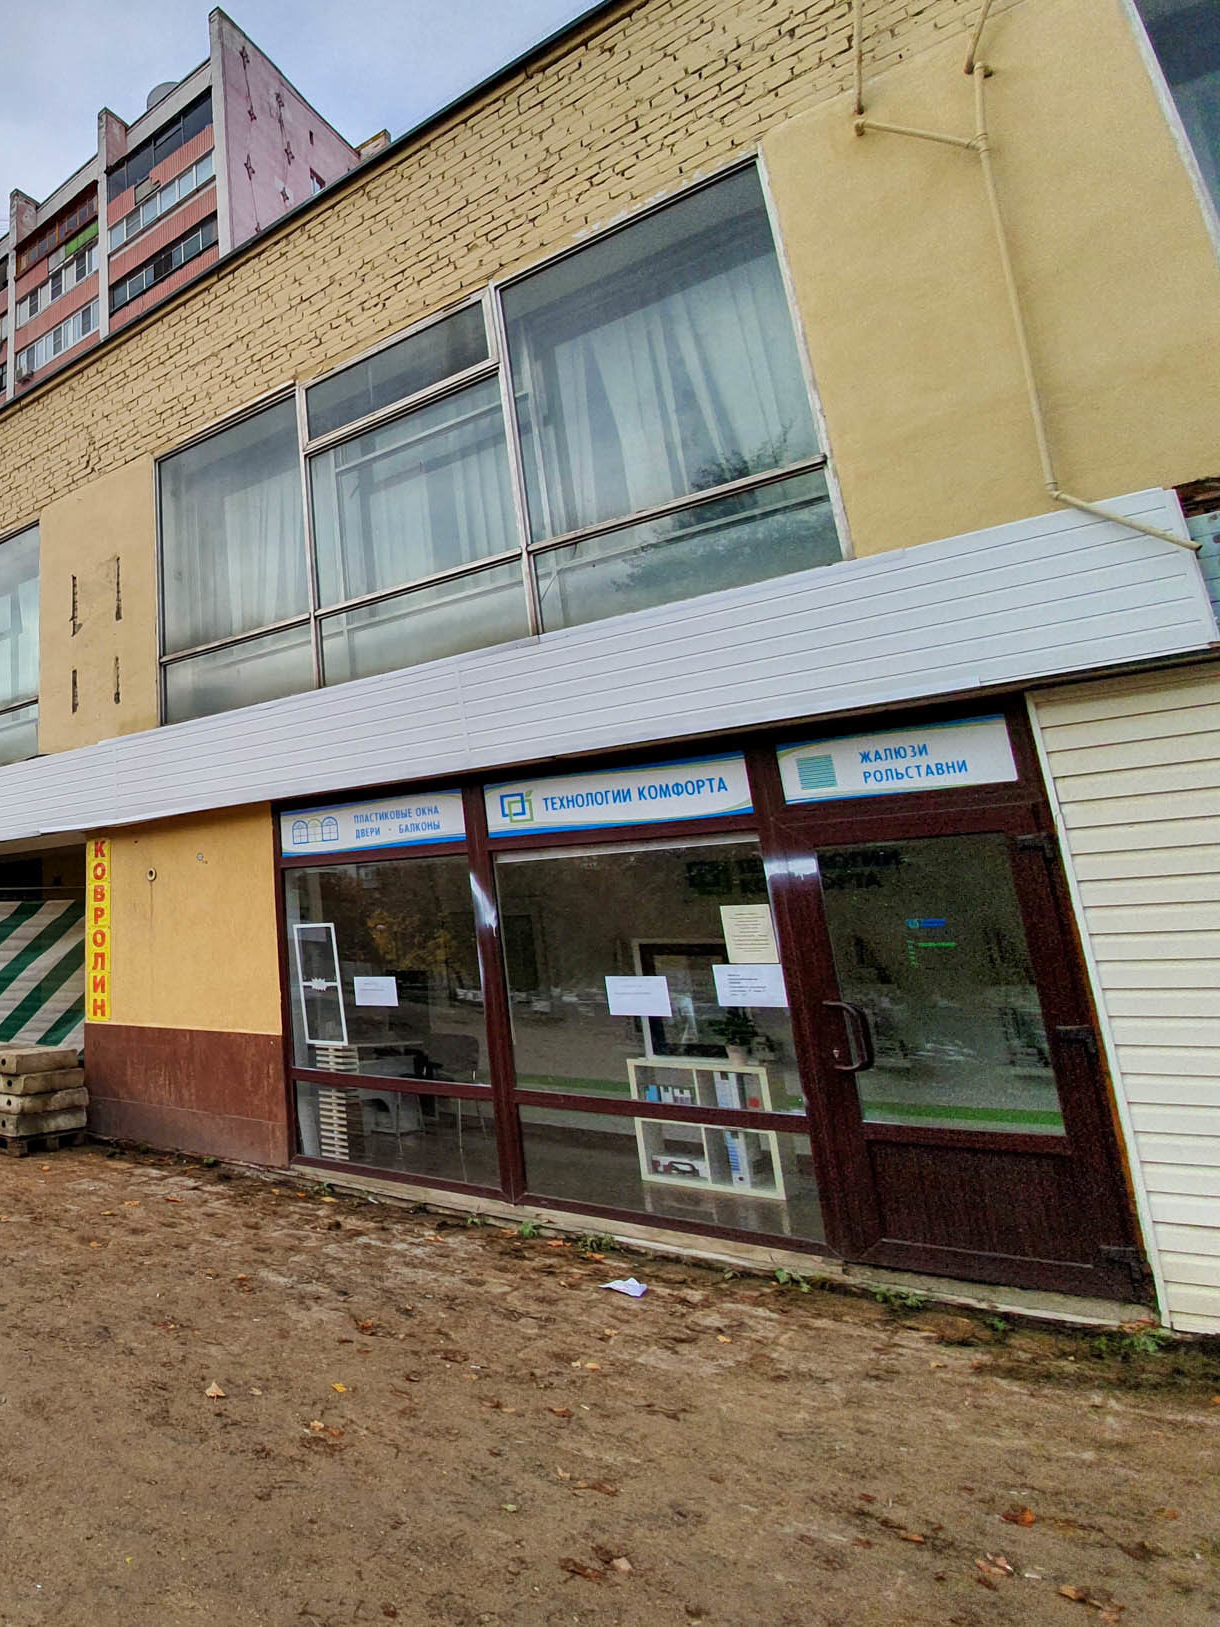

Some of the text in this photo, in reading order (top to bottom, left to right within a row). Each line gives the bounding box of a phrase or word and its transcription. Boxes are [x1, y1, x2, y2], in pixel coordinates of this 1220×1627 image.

[859, 743, 929, 764] ЖАЛЮЗИ
[863, 760, 969, 784] РОЛЬСТАВНИ
[542, 777, 728, 812] ТЕХНОЛОГИИ КОМФОРТА
[353, 805, 439, 824] ПЛАСТИКОВЫЕ ОКНА
[355, 821, 441, 840] ДВЕРИ БАЛКОНЫ
[92, 840, 106, 1017] КОВРОЛИН
